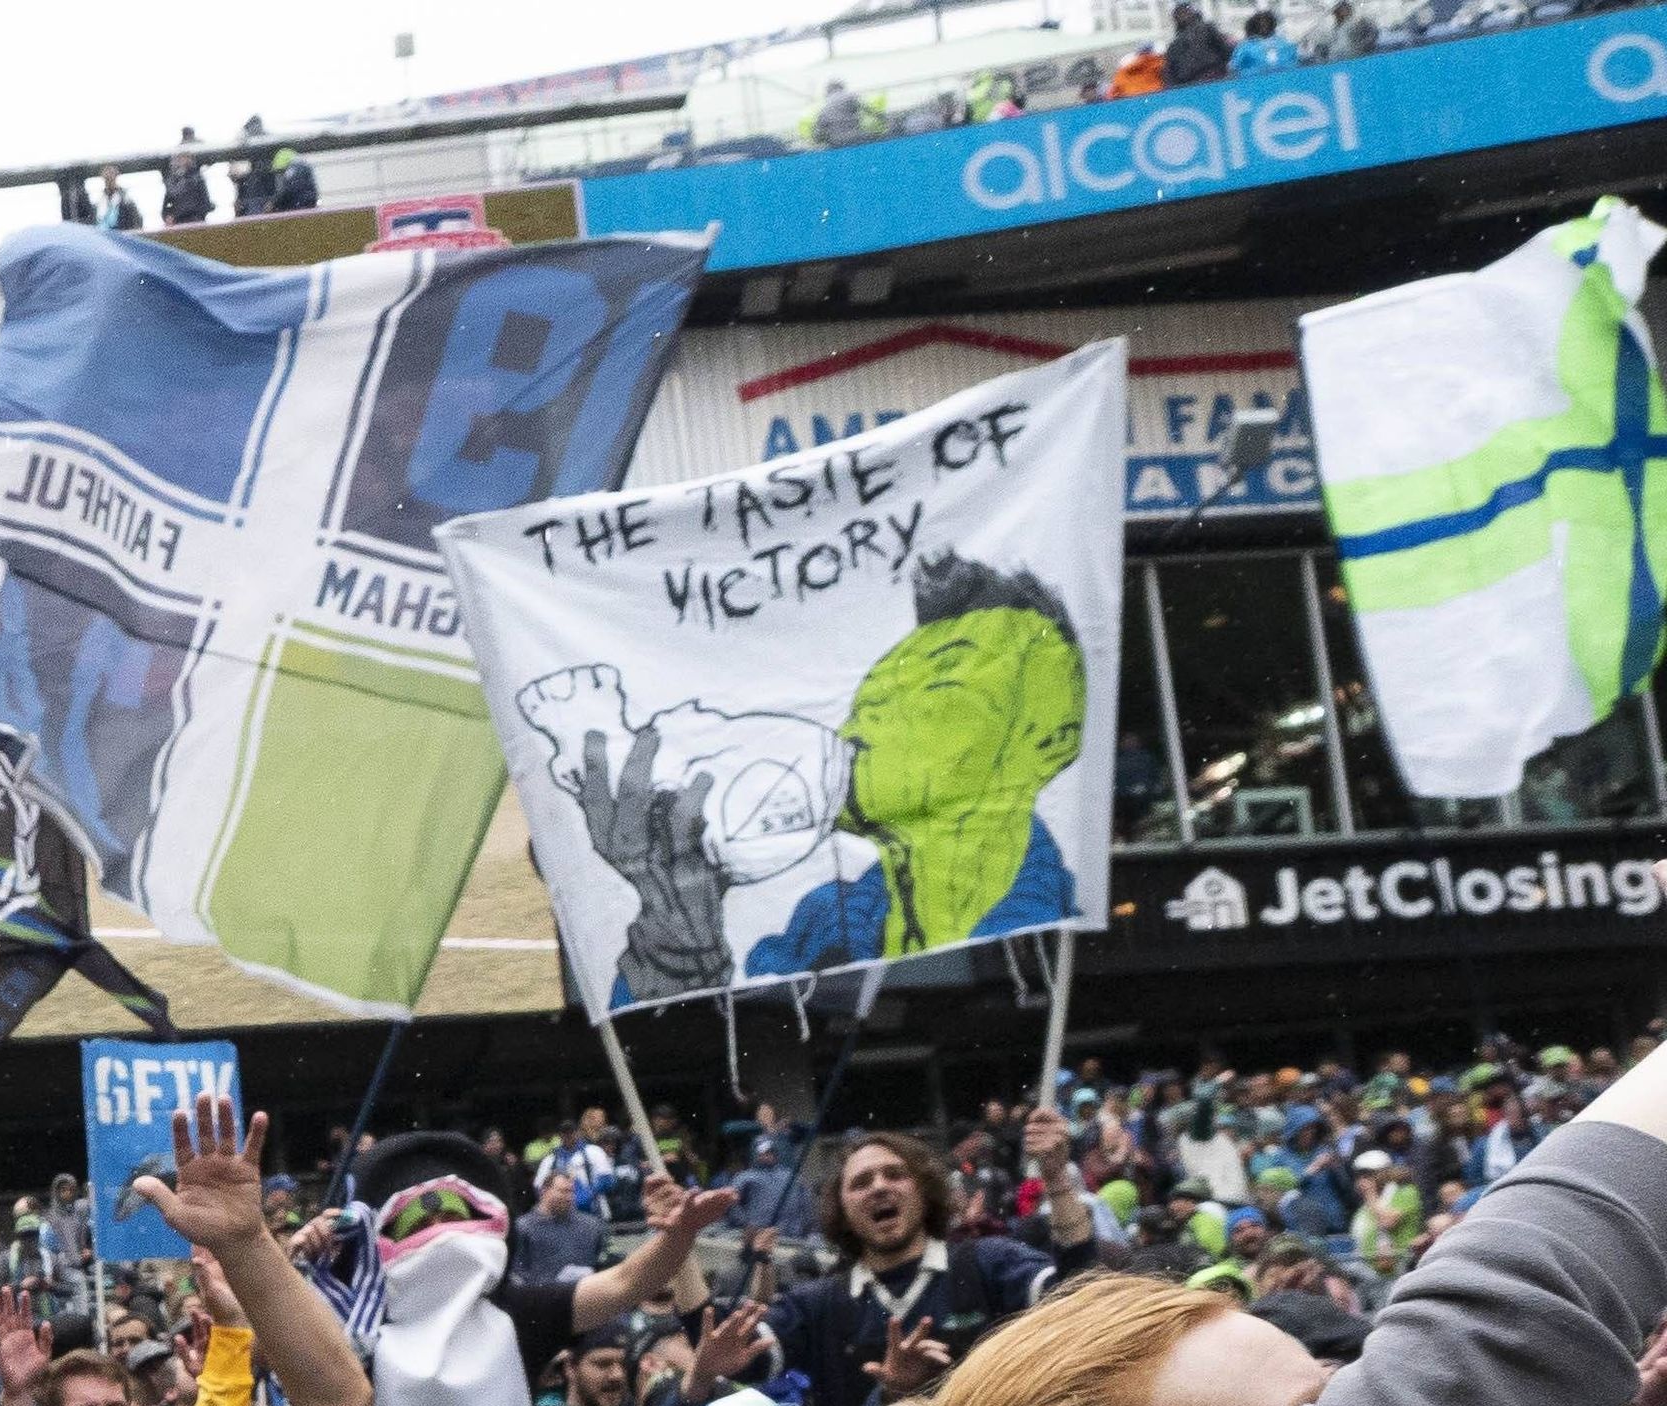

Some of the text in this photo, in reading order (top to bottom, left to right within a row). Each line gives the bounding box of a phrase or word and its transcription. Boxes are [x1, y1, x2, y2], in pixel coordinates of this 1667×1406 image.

[964, 74, 1360, 210] alcatel
[523, 499, 657, 572] THE
[930, 404, 1031, 470] OF
[664, 502, 925, 632] VICTORY
[1260, 850, 1664, 928] JetClosing
